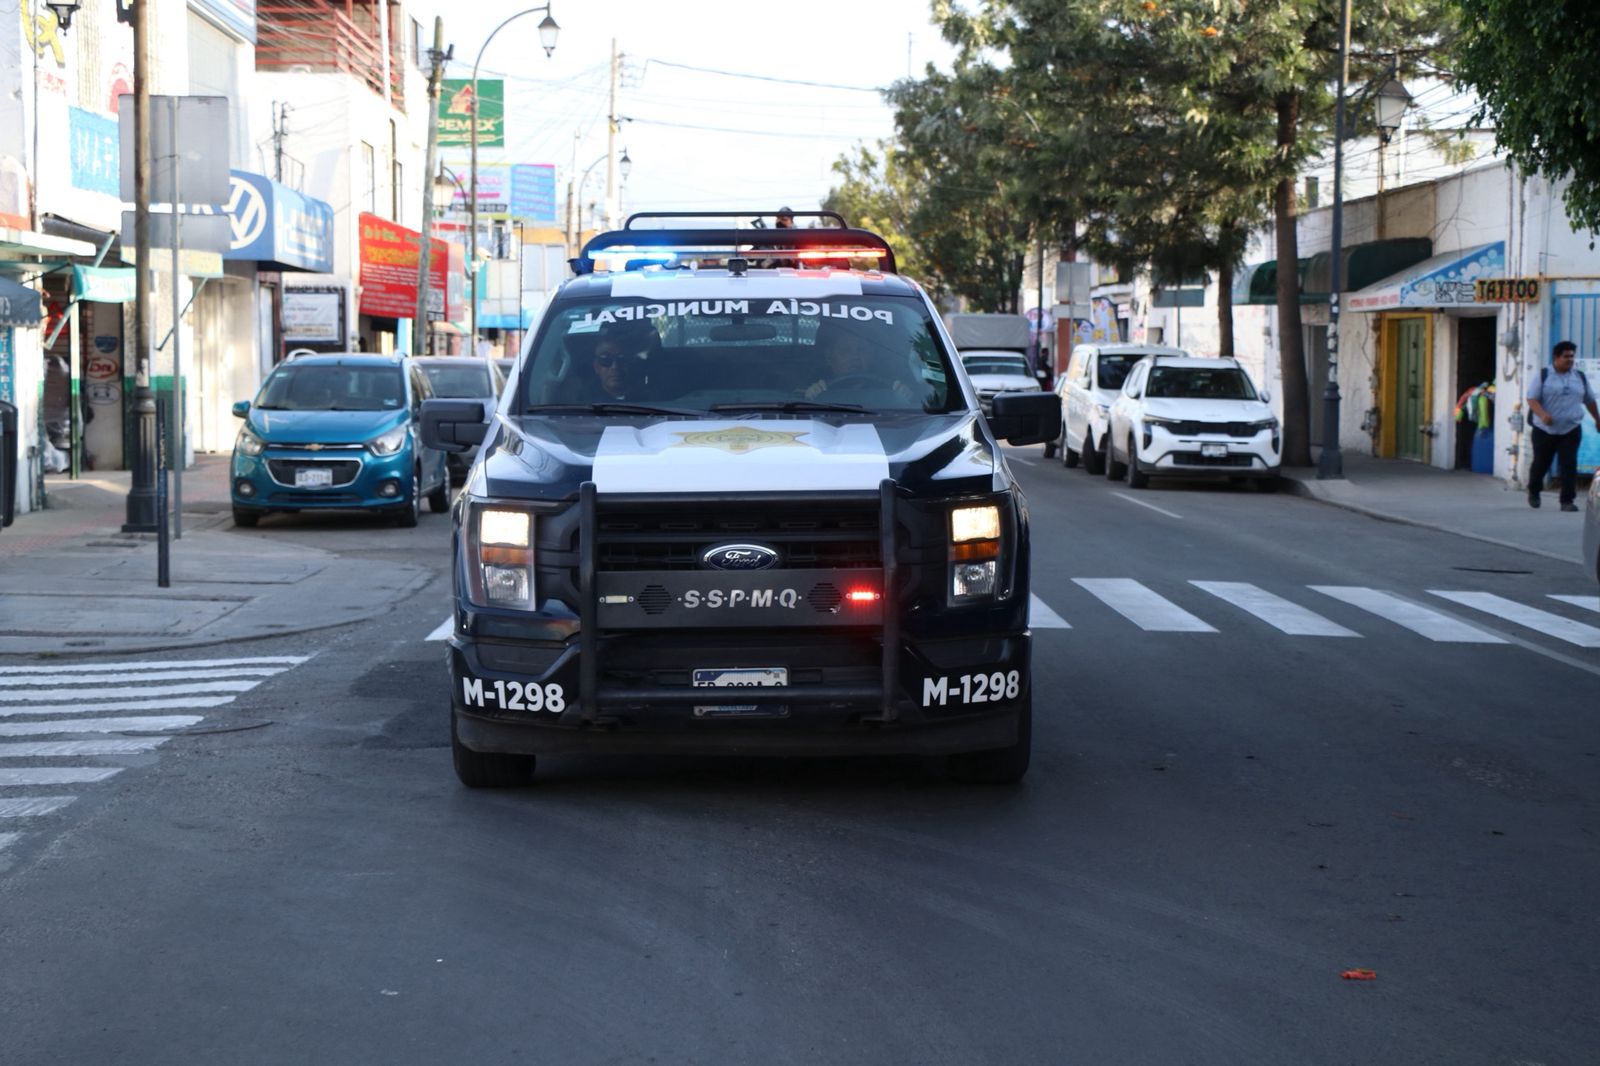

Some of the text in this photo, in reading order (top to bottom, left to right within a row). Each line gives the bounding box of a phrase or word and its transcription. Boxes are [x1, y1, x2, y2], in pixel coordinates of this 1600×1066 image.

[1477, 279, 1539, 300] TATTOO
[721, 550, 762, 567] Ford
[462, 676, 566, 713] M-1298
[922, 669, 1020, 707] M-1298
